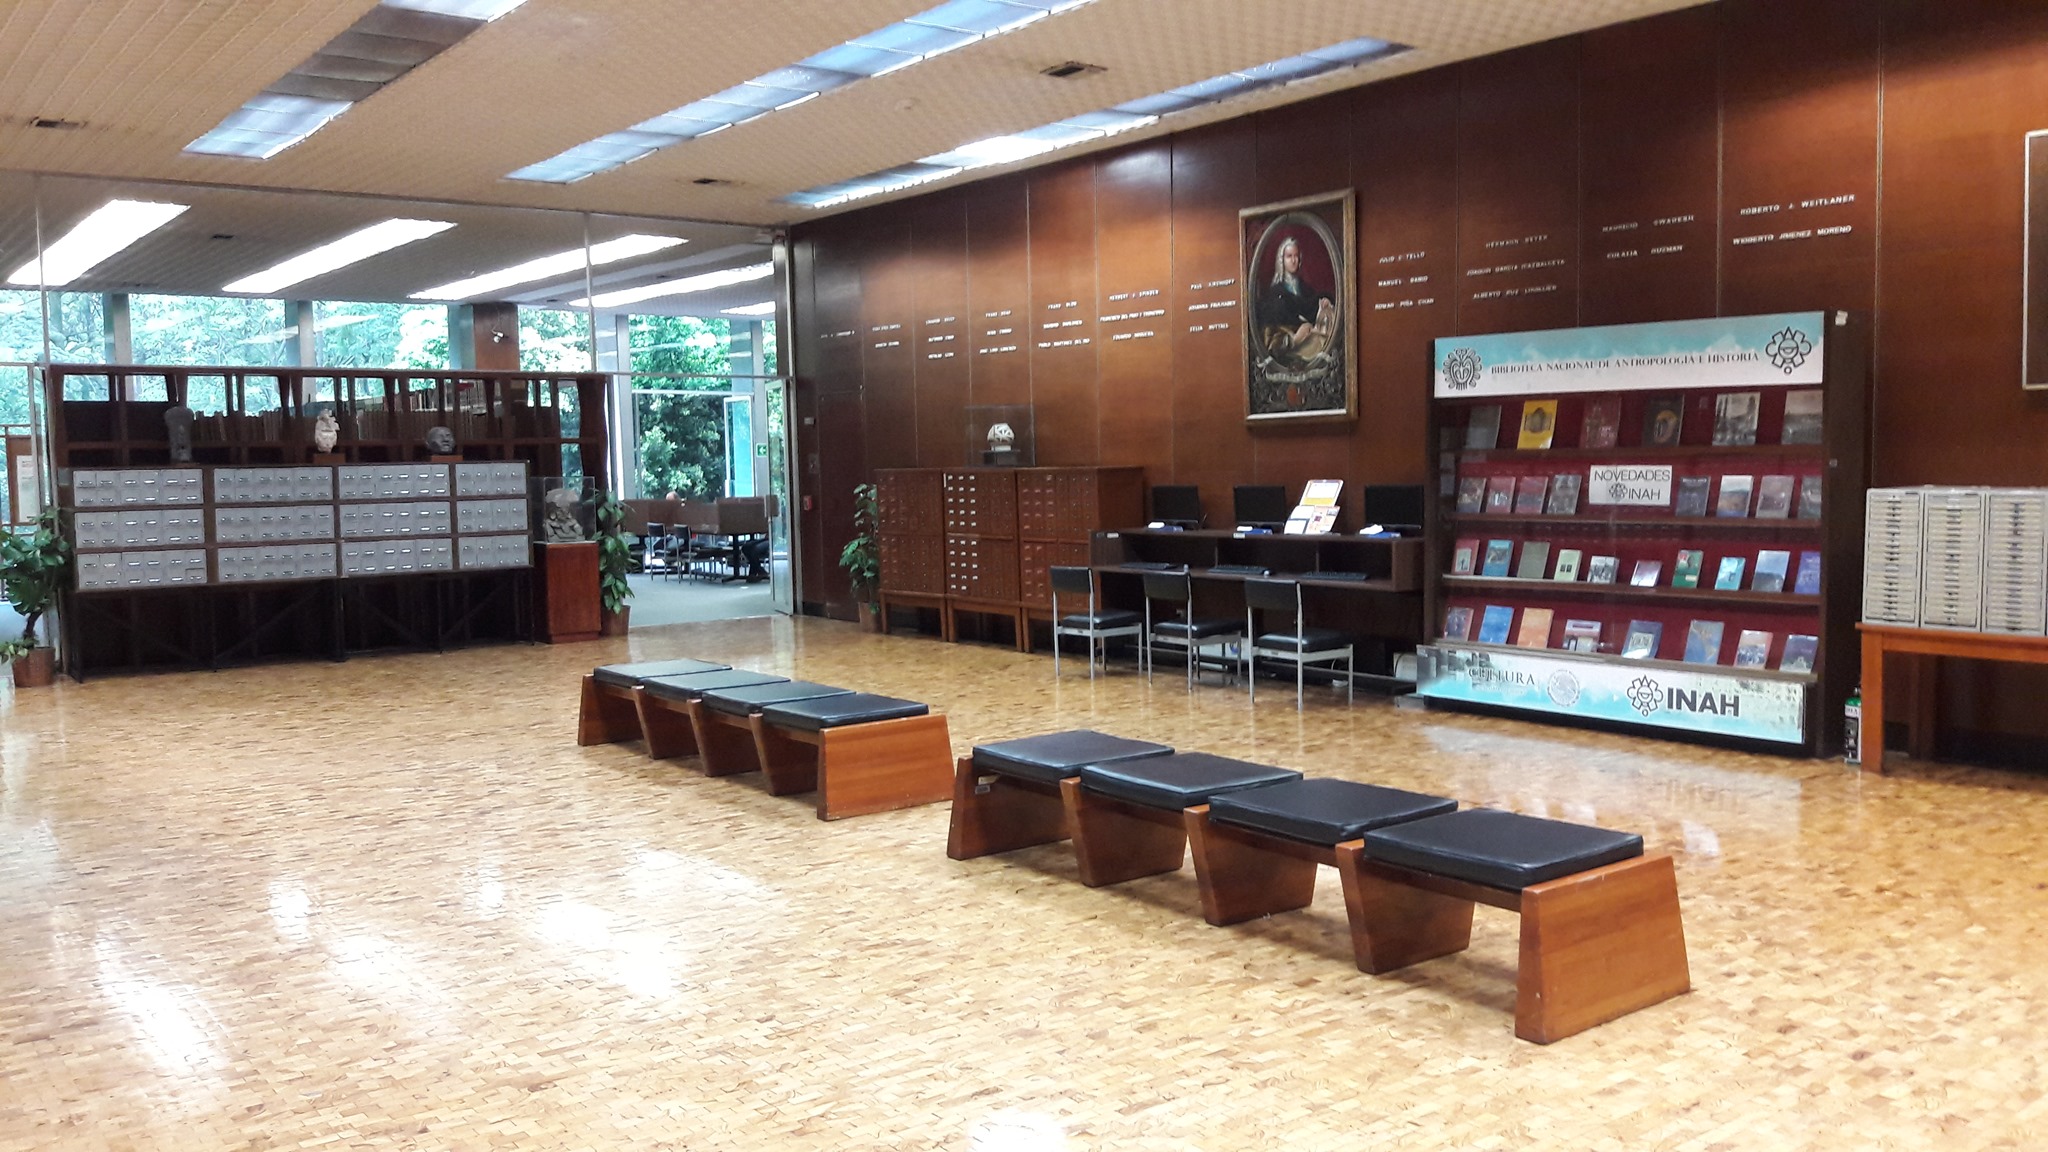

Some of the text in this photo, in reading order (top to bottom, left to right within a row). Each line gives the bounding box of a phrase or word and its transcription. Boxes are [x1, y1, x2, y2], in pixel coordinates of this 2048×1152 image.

[1740, 204, 1780, 215] ROBERTO
[1817, 225, 1852, 236] MORENO
[1491, 363, 1543, 374] BIBLIOTECA
[1546, 360, 1594, 371] NACIONAL
[1708, 352, 1759, 363] HISTORIA
[1594, 469, 1671, 482] NOVEDADES
[1628, 488, 1661, 500] INAH
[1667, 687, 1740, 717] INAH
